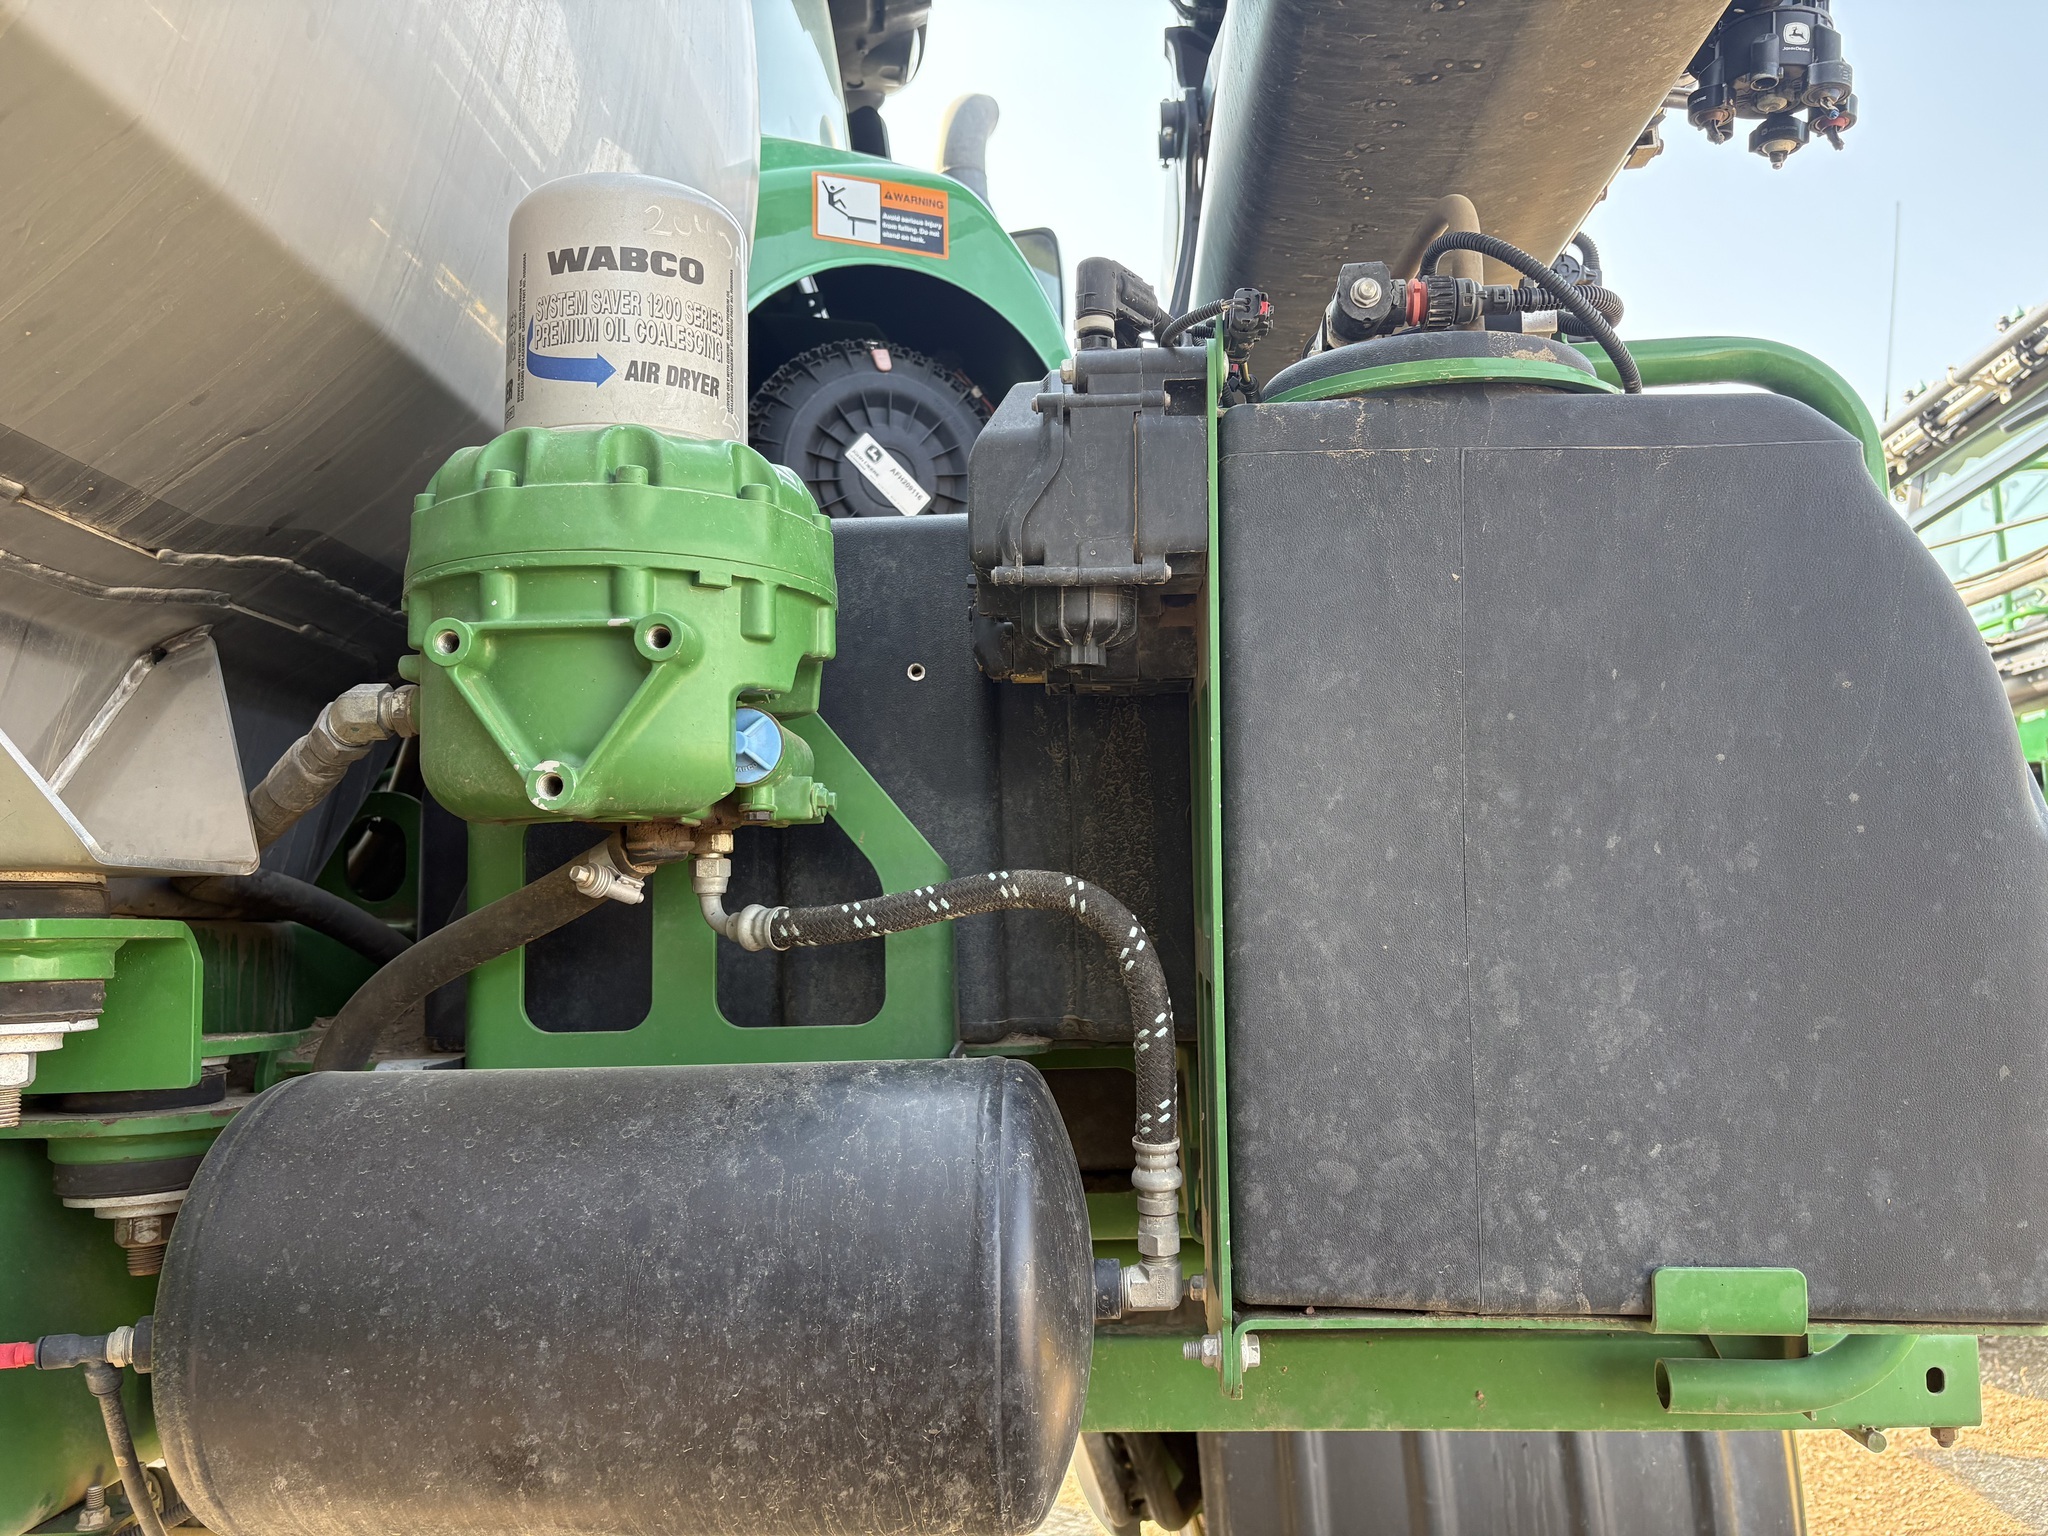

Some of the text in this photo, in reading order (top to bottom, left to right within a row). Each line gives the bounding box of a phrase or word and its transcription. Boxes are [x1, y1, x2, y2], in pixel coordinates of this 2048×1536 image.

[893, 192, 944, 210] WARNING
[882, 212, 942, 230] Avoid serious injury
[882, 221, 897, 230] from
[919, 228, 929, 236] Do
[929, 230, 940, 238] not
[882, 231, 900, 240] stand
[547, 245, 704, 285] WABCO
[536, 289, 724, 337] SYSTEM SAVER 1200 SERIES
[534, 318, 599, 350] PREMIUM
[603, 317, 630, 342] OIL
[634, 319, 723, 363] COALESCING
[624, 360, 720, 399] AIR DRYER
